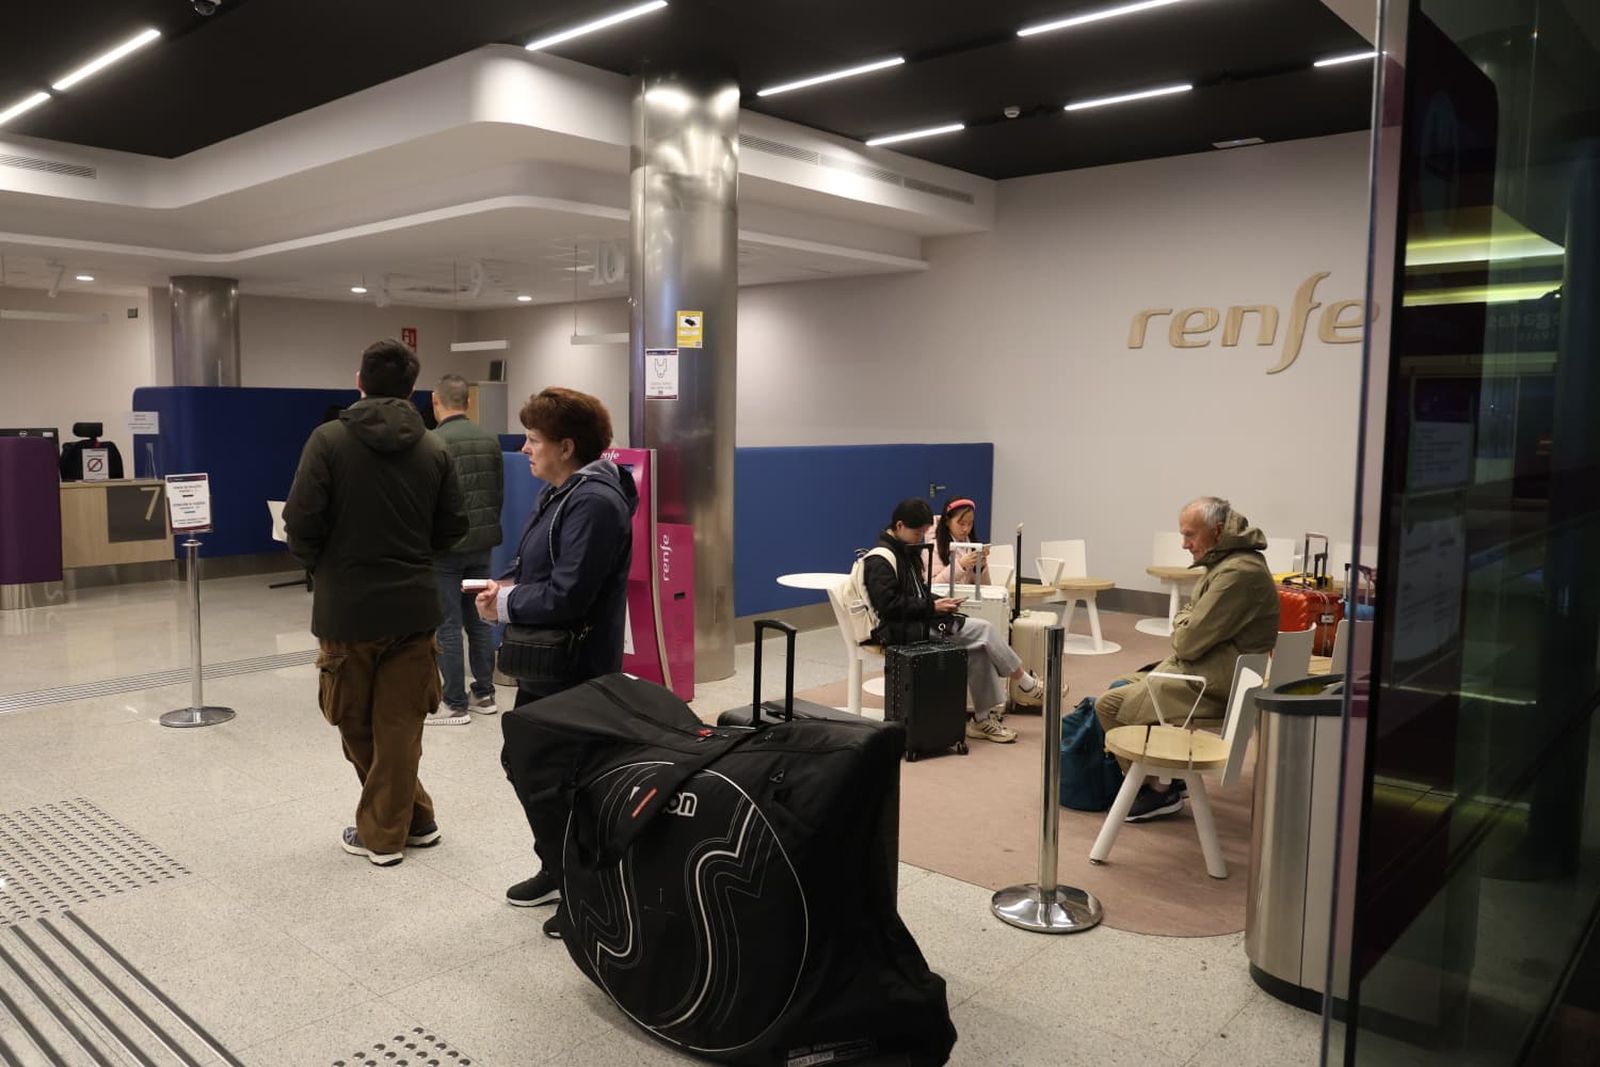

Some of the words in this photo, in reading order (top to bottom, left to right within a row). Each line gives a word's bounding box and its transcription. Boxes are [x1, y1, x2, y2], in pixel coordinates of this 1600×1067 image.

[1127, 271, 1380, 375] renfe
[599, 449, 620, 462] enfe
[140, 486, 161, 521] 7
[660, 534, 672, 581] renfe
